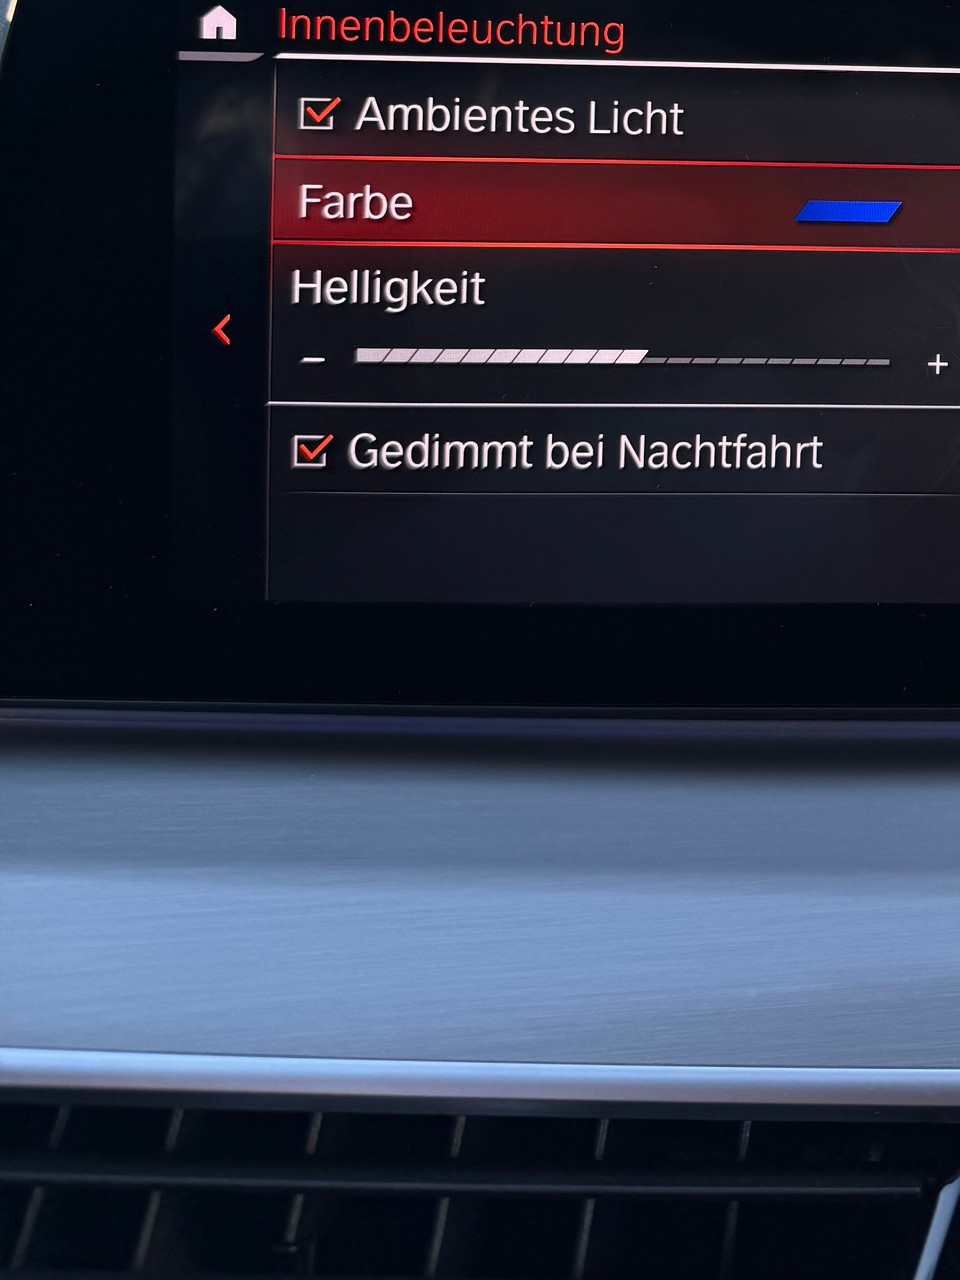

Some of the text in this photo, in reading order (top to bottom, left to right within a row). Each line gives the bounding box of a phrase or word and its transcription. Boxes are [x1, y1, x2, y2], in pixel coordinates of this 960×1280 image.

[278, 7, 625, 53] Innenbeleuchtung
[354, 96, 685, 137] Ambientes Licht
[297, 183, 414, 221] Farbe
[290, 268, 487, 313] Helligkeit
[348, 431, 824, 470] Gedimmt bei Nachtfahrt
